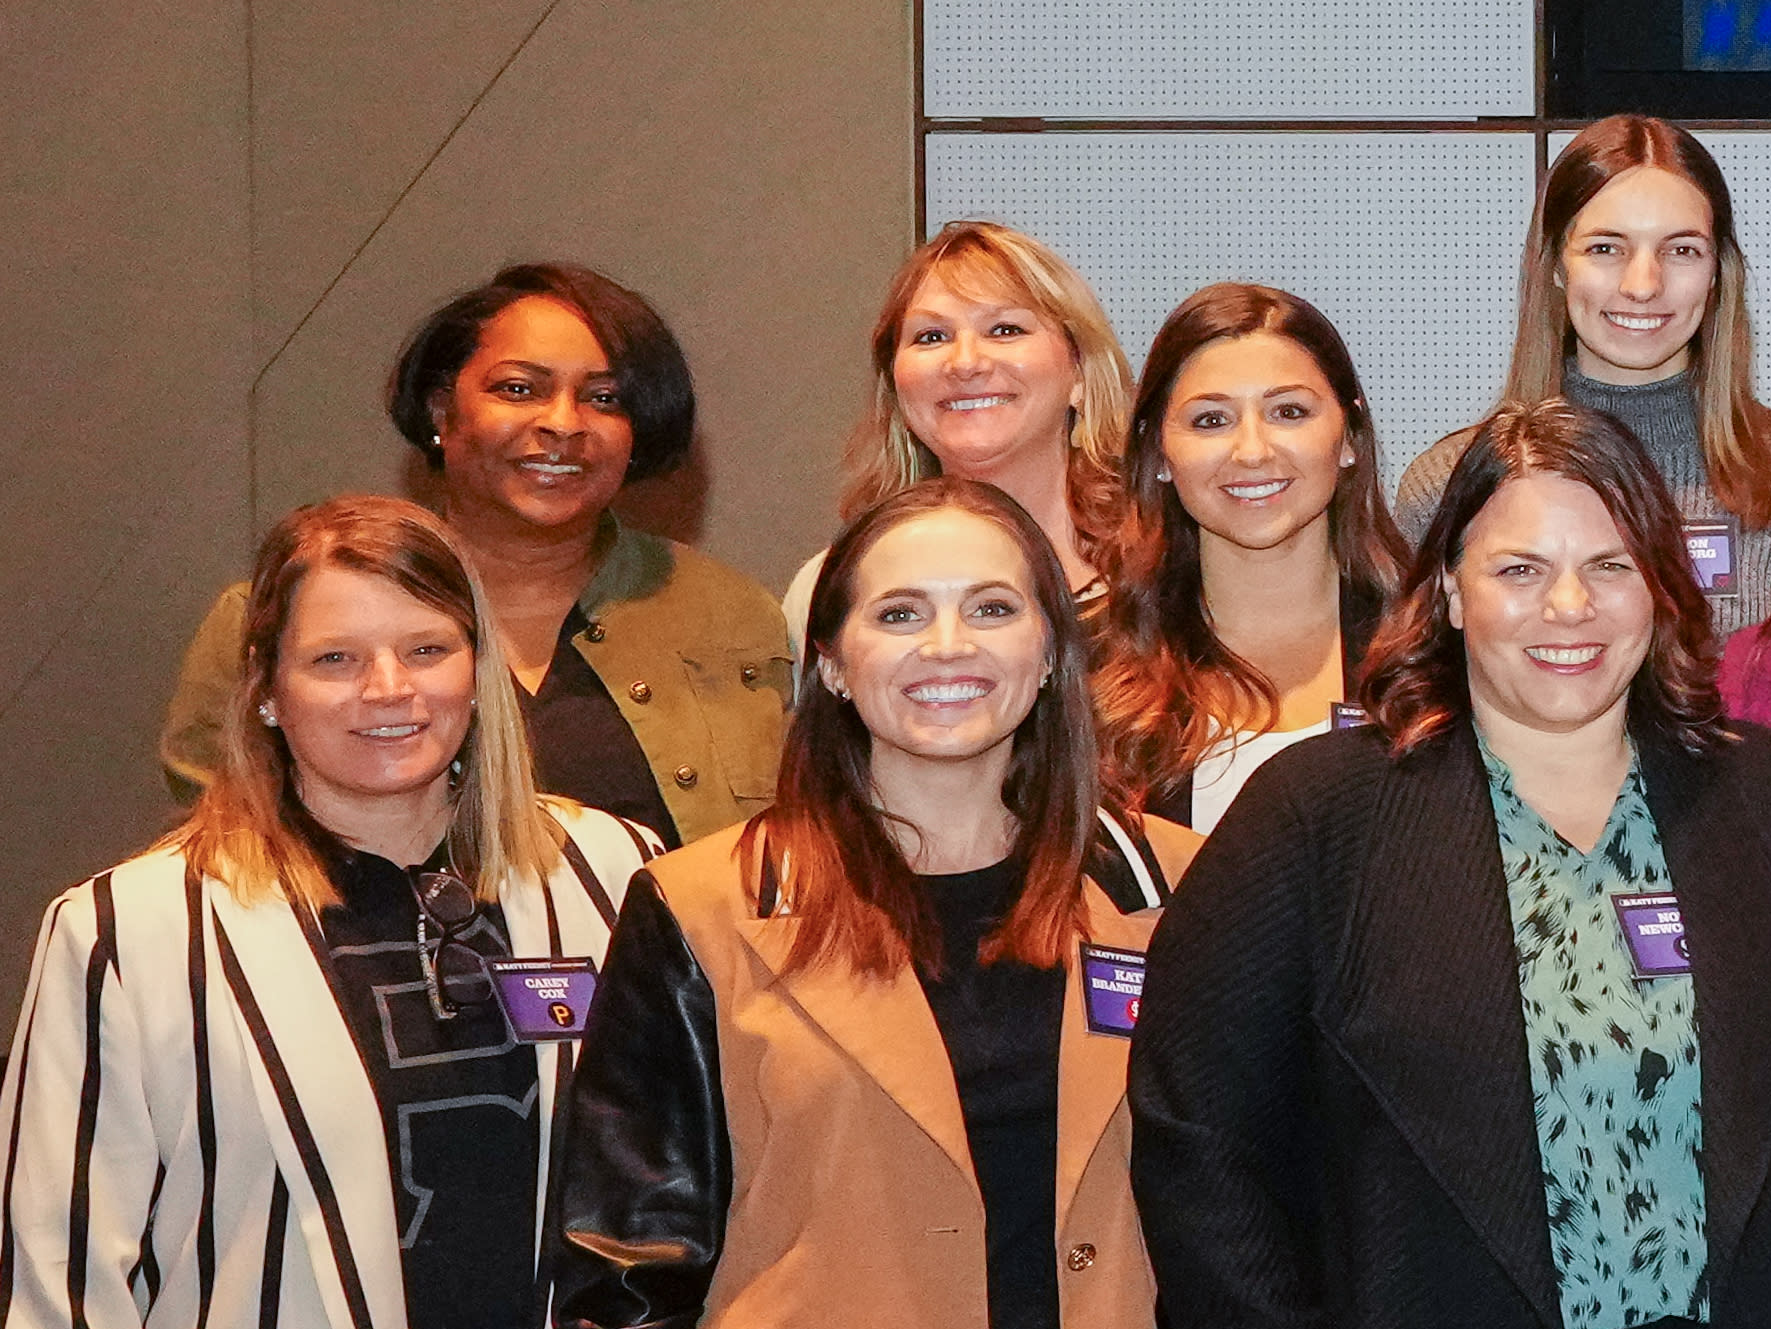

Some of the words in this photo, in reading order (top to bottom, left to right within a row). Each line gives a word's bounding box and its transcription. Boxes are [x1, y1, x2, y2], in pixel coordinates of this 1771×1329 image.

[525, 977, 570, 989] CAREY
[1114, 969, 1145, 984] KAT
[1091, 977, 1143, 996] BRANDE
[538, 988, 568, 1000] COX
